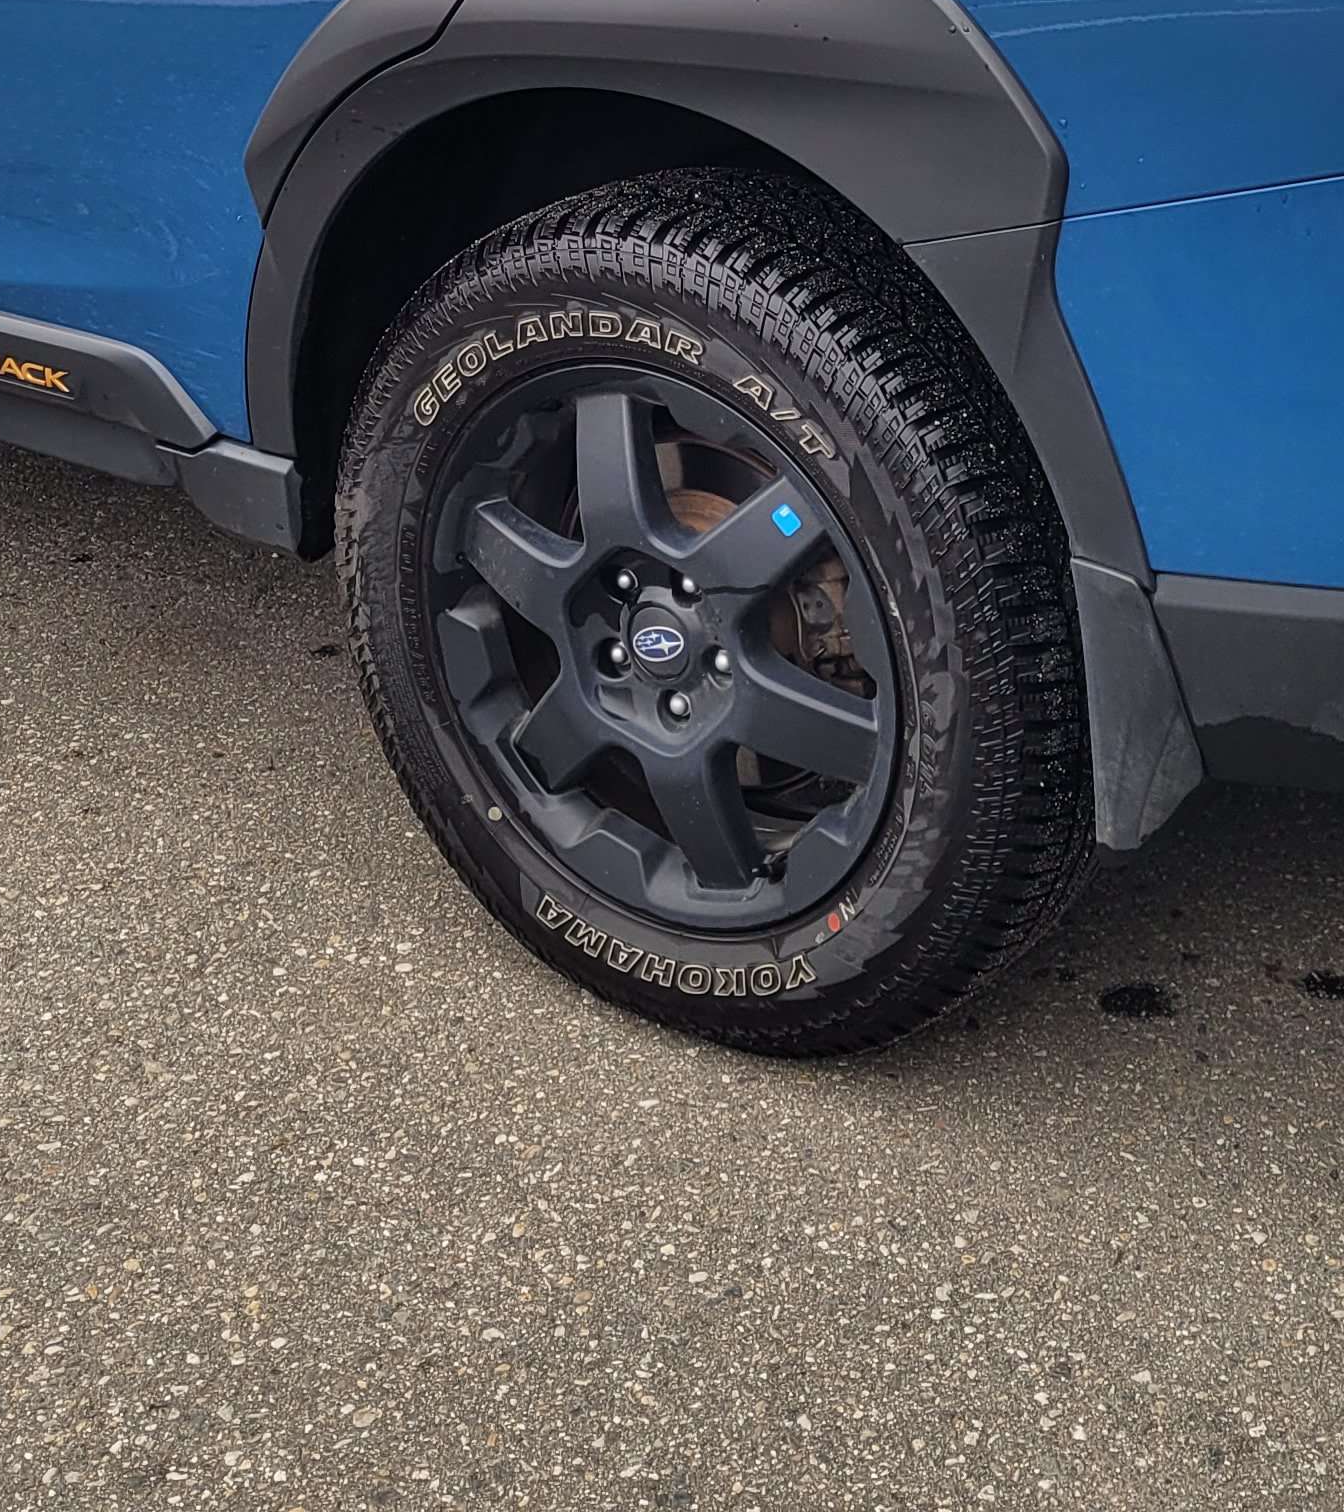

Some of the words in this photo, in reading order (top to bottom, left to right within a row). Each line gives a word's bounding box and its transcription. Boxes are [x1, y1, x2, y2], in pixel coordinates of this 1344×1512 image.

[413, 310, 705, 427] GEOLANDAR
[732, 374, 837, 461] A/T
[535, 893, 816, 997] YOKOHAMA
